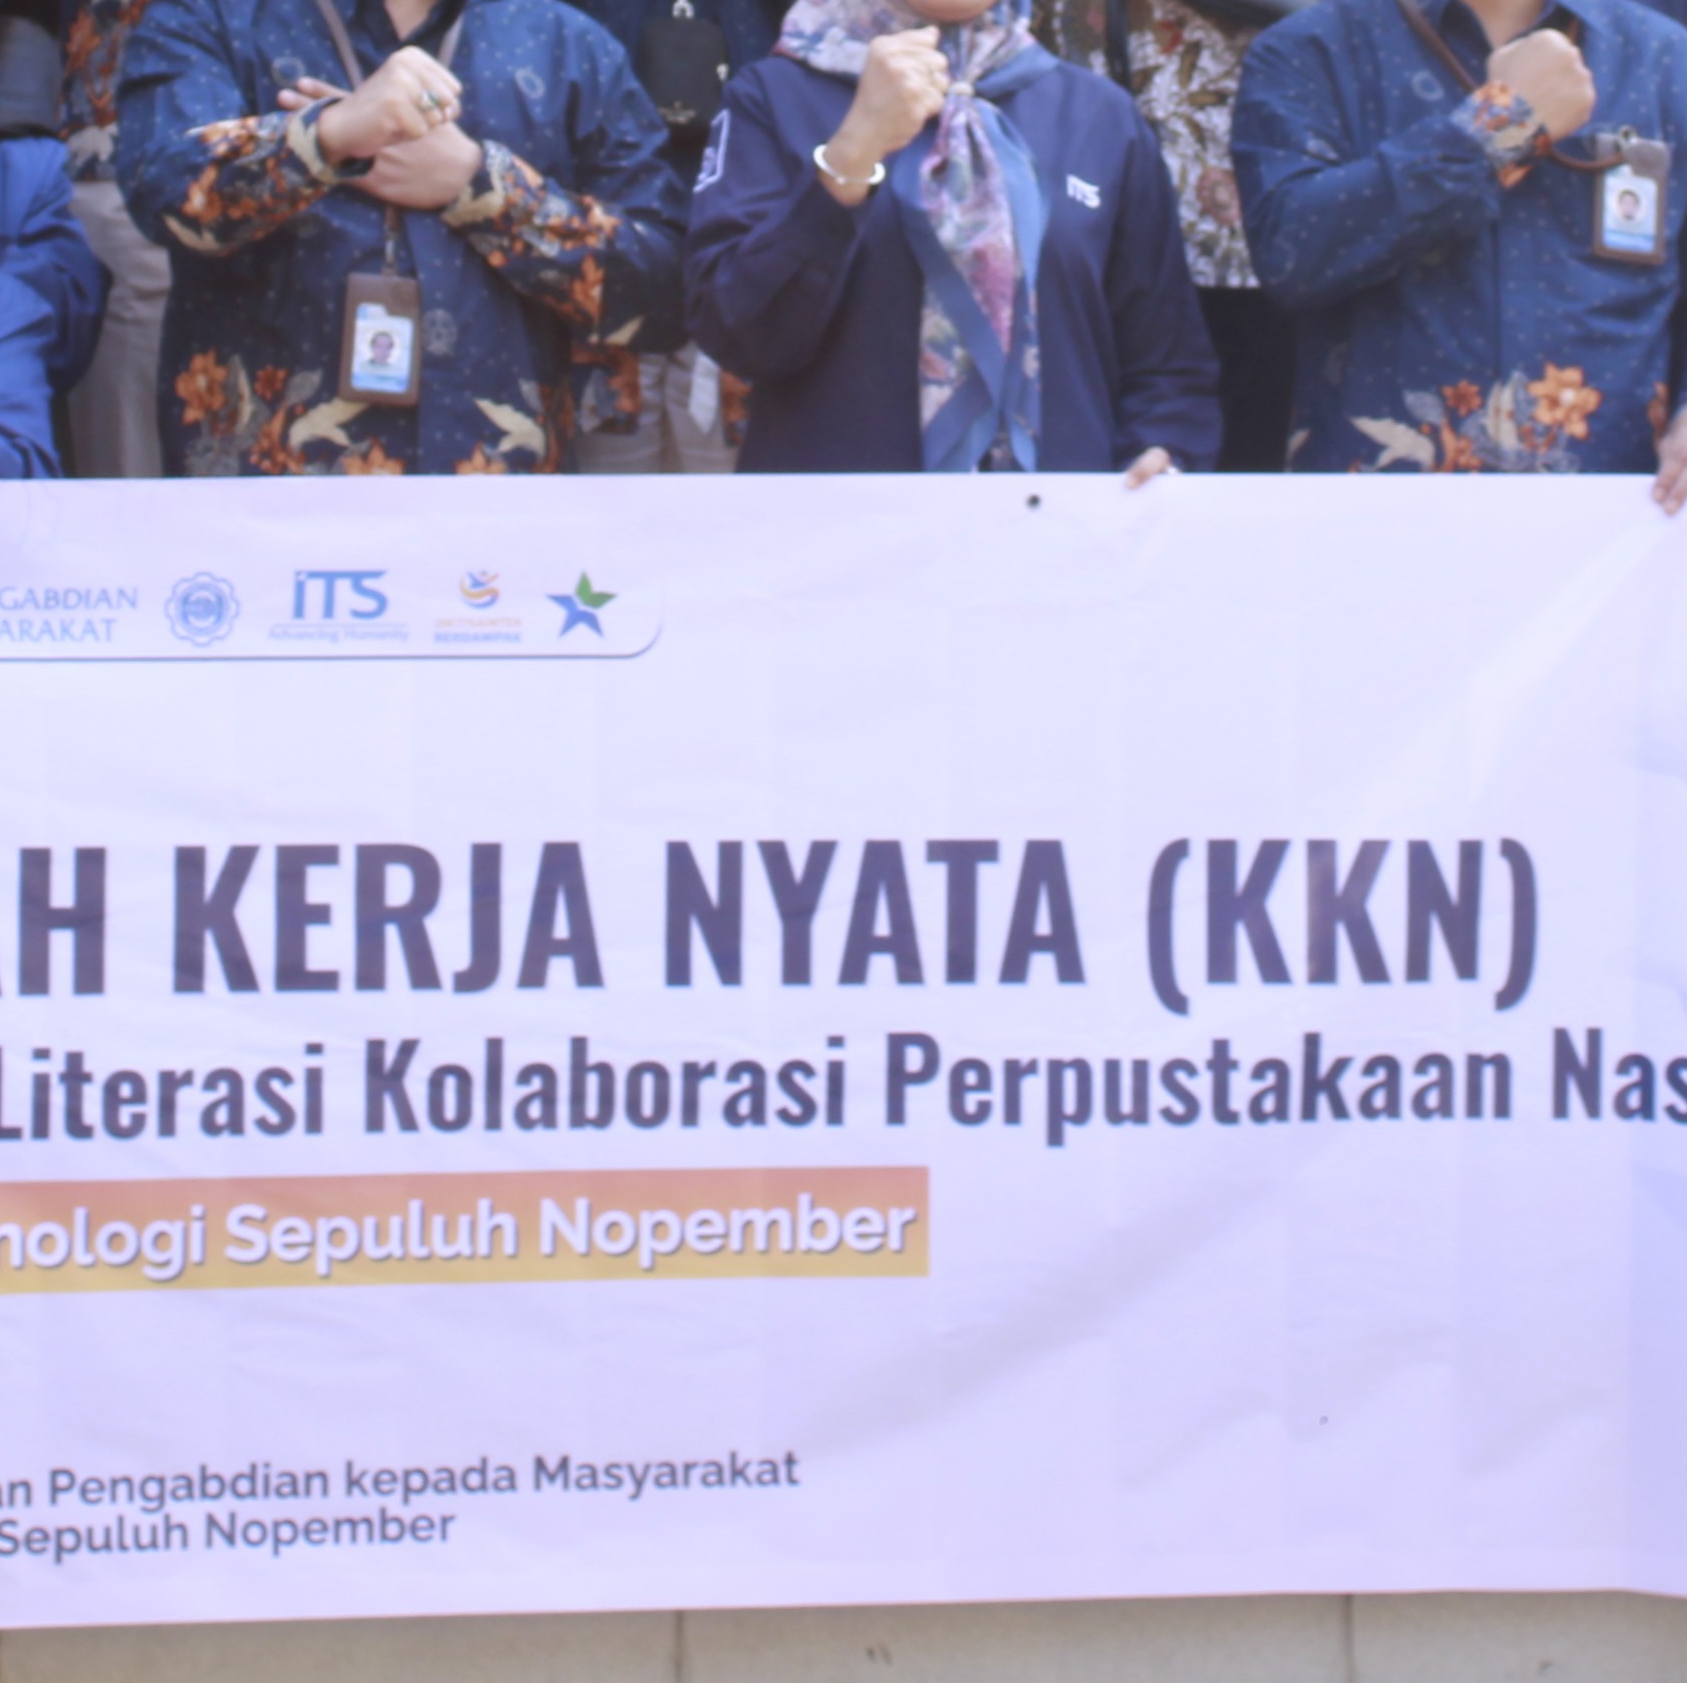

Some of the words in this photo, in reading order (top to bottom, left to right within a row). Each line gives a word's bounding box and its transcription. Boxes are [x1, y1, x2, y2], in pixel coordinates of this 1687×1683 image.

[1066, 174, 1101, 209] ITS
[292, 570, 388, 620] ITS
[267, 628, 340, 644] Advancing
[343, 628, 410, 643] Humanity
[171, 841, 605, 996] KERJA
[664, 839, 1087, 989] NYATA
[1146, 837, 1539, 1018] (KKN)
[364, 1035, 846, 1135] Kolaborasi
[885, 1032, 1513, 1149] Perpustakaan
[225, 1198, 517, 1275] Sepuluh
[539, 1193, 917, 1269] Nopember
[48, 1462, 330, 1518] Pengabdian
[345, 1456, 518, 1508] kepada
[533, 1451, 800, 1503] Masyarakat
[205, 1507, 456, 1559] Nopember
